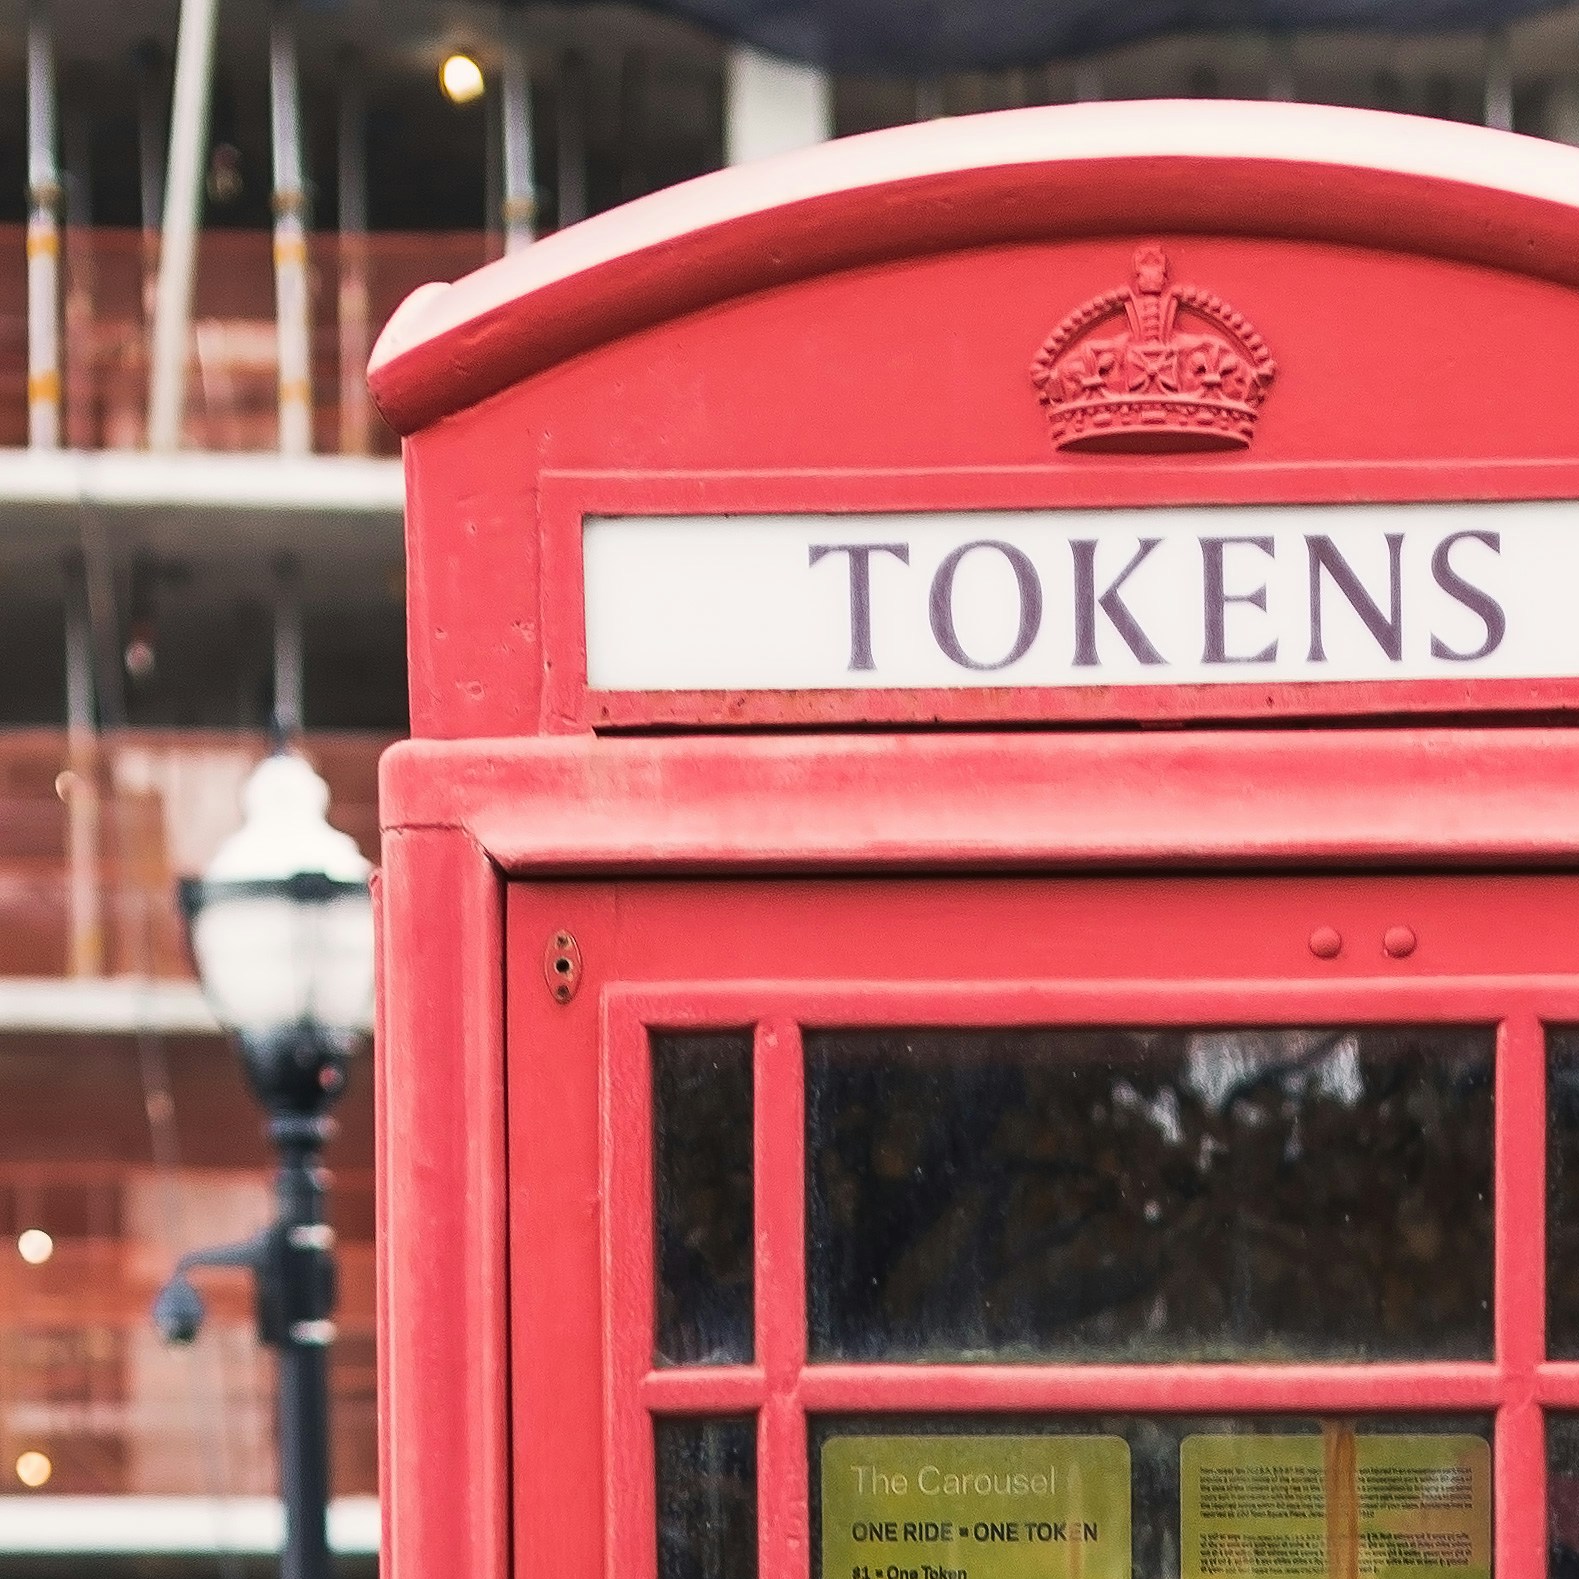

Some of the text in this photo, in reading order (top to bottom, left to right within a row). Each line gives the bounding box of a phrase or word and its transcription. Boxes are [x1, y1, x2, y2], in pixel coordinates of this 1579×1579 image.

[808, 528, 1507, 672] TOKENS
[850, 1464, 1056, 1496] The Carousel
[851, 1521, 899, 1543] ONE
[903, 1521, 954, 1543] RIDE
[973, 1521, 1019, 1543] ONE
[1024, 1521, 1098, 1543] TOKEN
